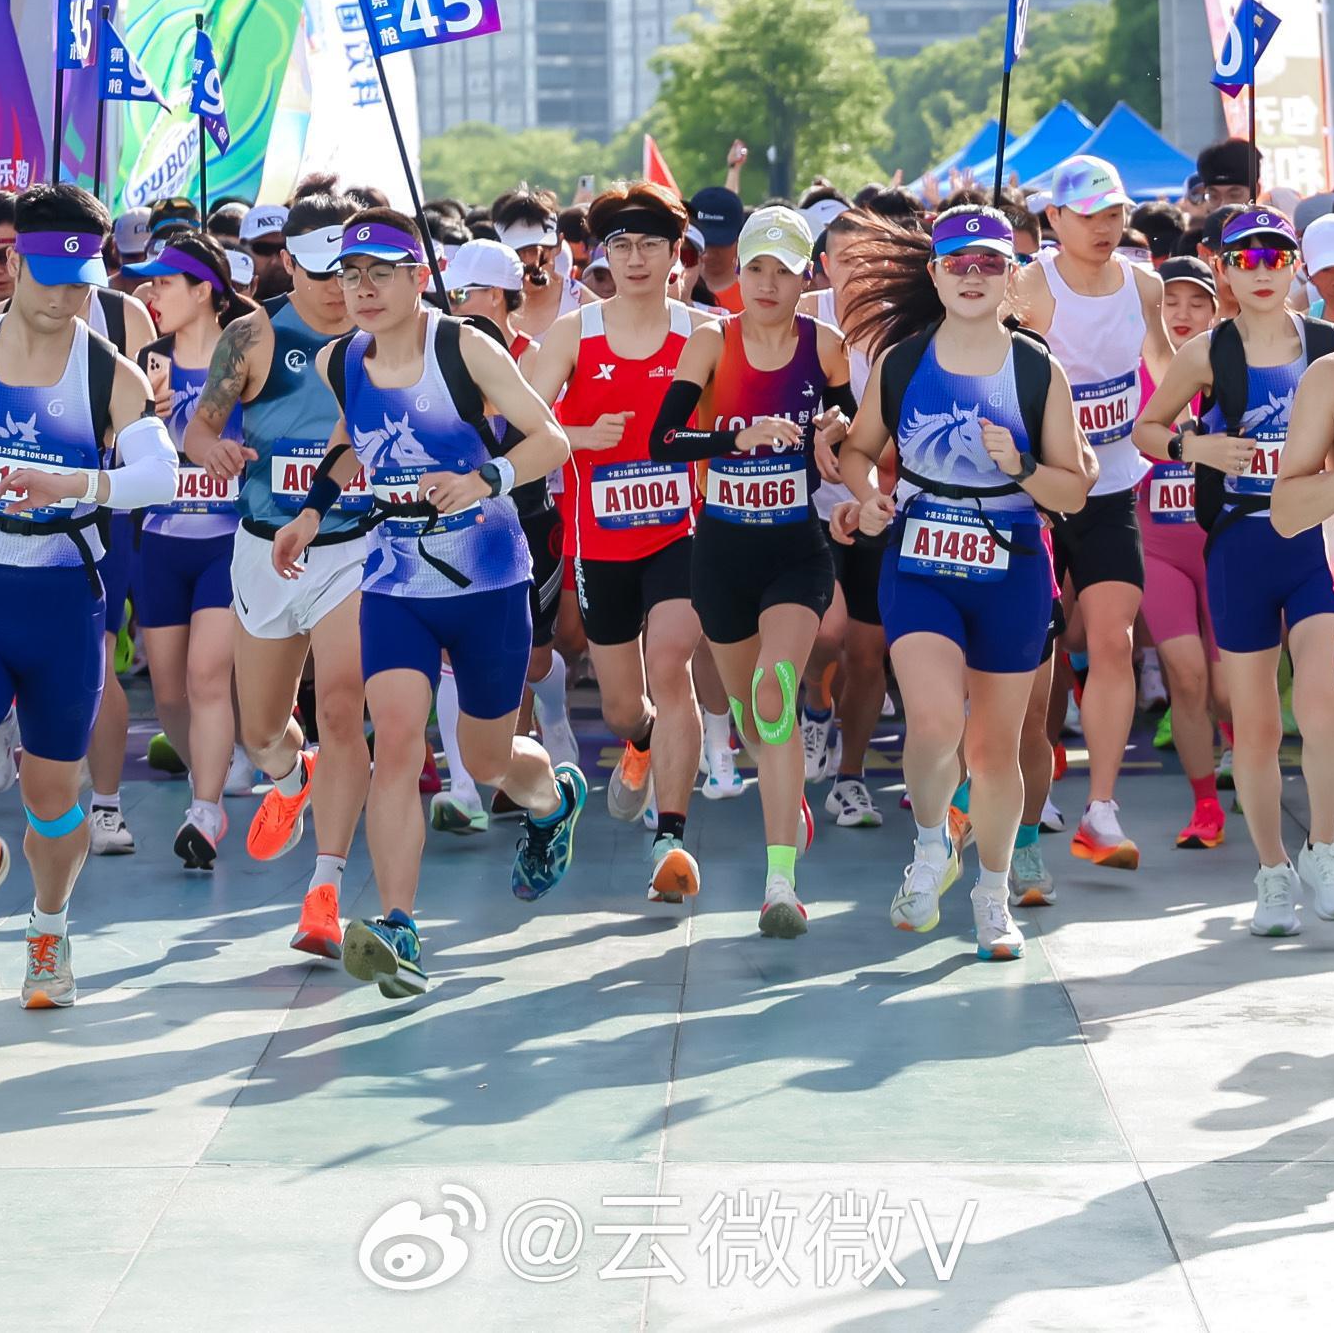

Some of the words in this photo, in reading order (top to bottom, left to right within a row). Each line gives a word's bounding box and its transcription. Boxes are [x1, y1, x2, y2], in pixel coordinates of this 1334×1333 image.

[108, 47, 125, 95] 第一枪
[1079, 396, 1128, 431] A0141
[605, 479, 680, 514] A1004
[718, 478, 796, 509] A1466
[913, 526, 997, 564] A1483
